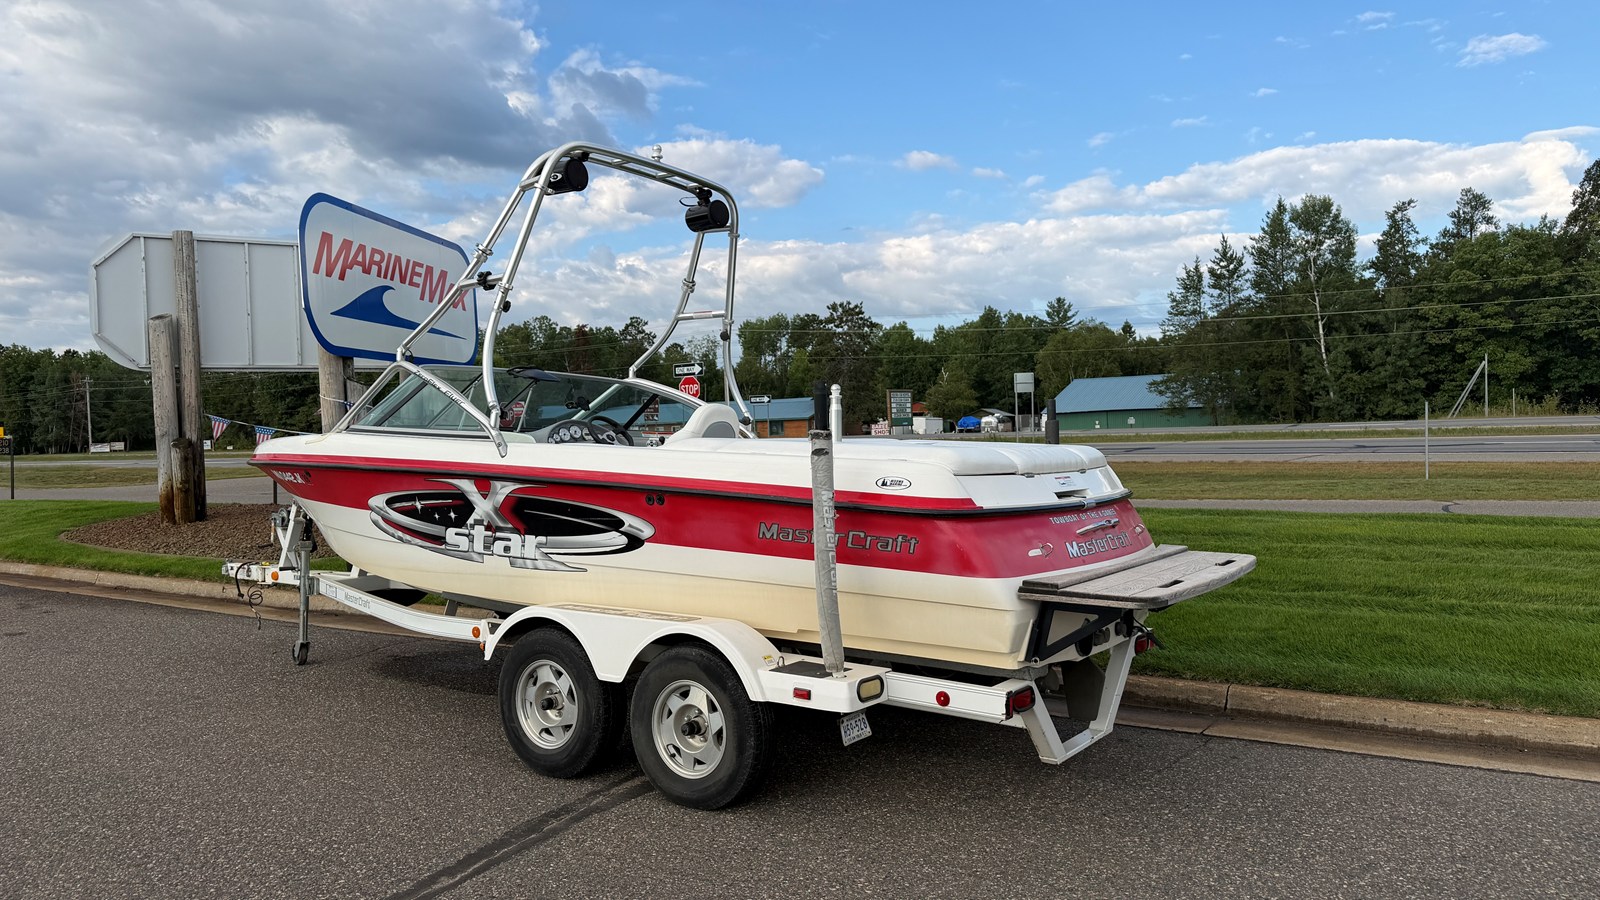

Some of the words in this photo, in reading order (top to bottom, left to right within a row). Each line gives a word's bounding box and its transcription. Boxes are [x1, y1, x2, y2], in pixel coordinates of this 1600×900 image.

[680, 384, 699, 395] STOP
[1049, 513, 1080, 525] TOWBOAT
[1079, 511, 1088, 521] OF
[1087, 510, 1099, 519] THE
[445, 518, 551, 561] star
[1064, 531, 1132, 559] MasterCraft
